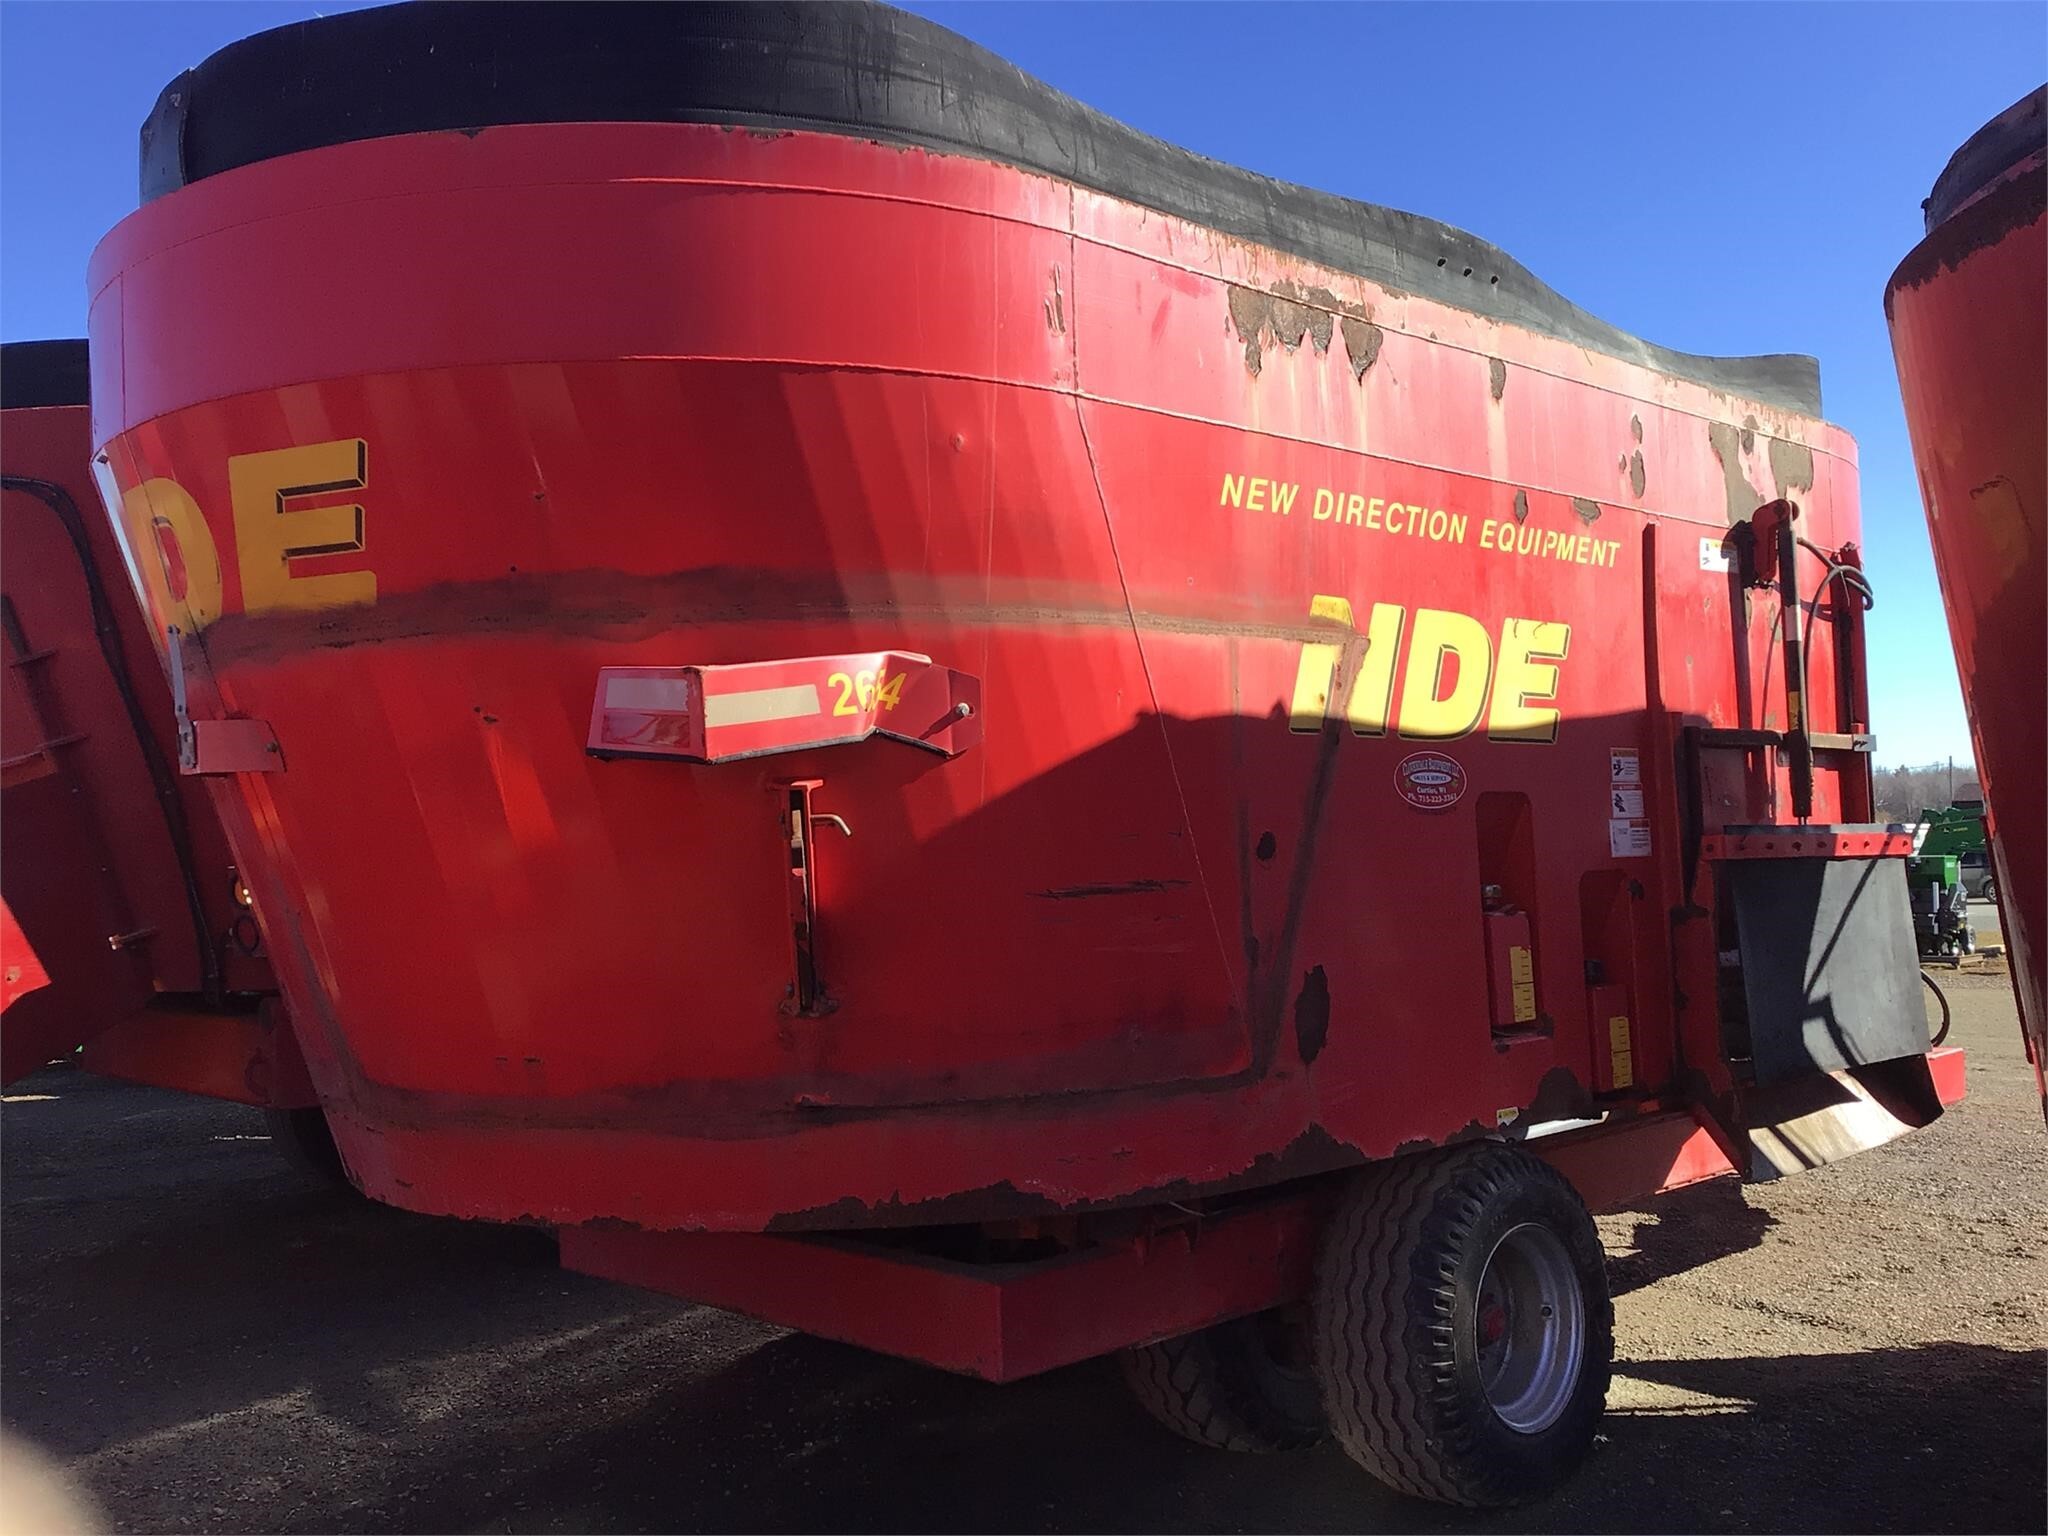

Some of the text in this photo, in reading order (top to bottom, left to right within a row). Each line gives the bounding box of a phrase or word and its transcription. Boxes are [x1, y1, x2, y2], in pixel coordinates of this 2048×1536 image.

[1220, 473, 1621, 568] NEW DIRECTION EQUIPMENT
[1288, 594, 1572, 744] NDE
